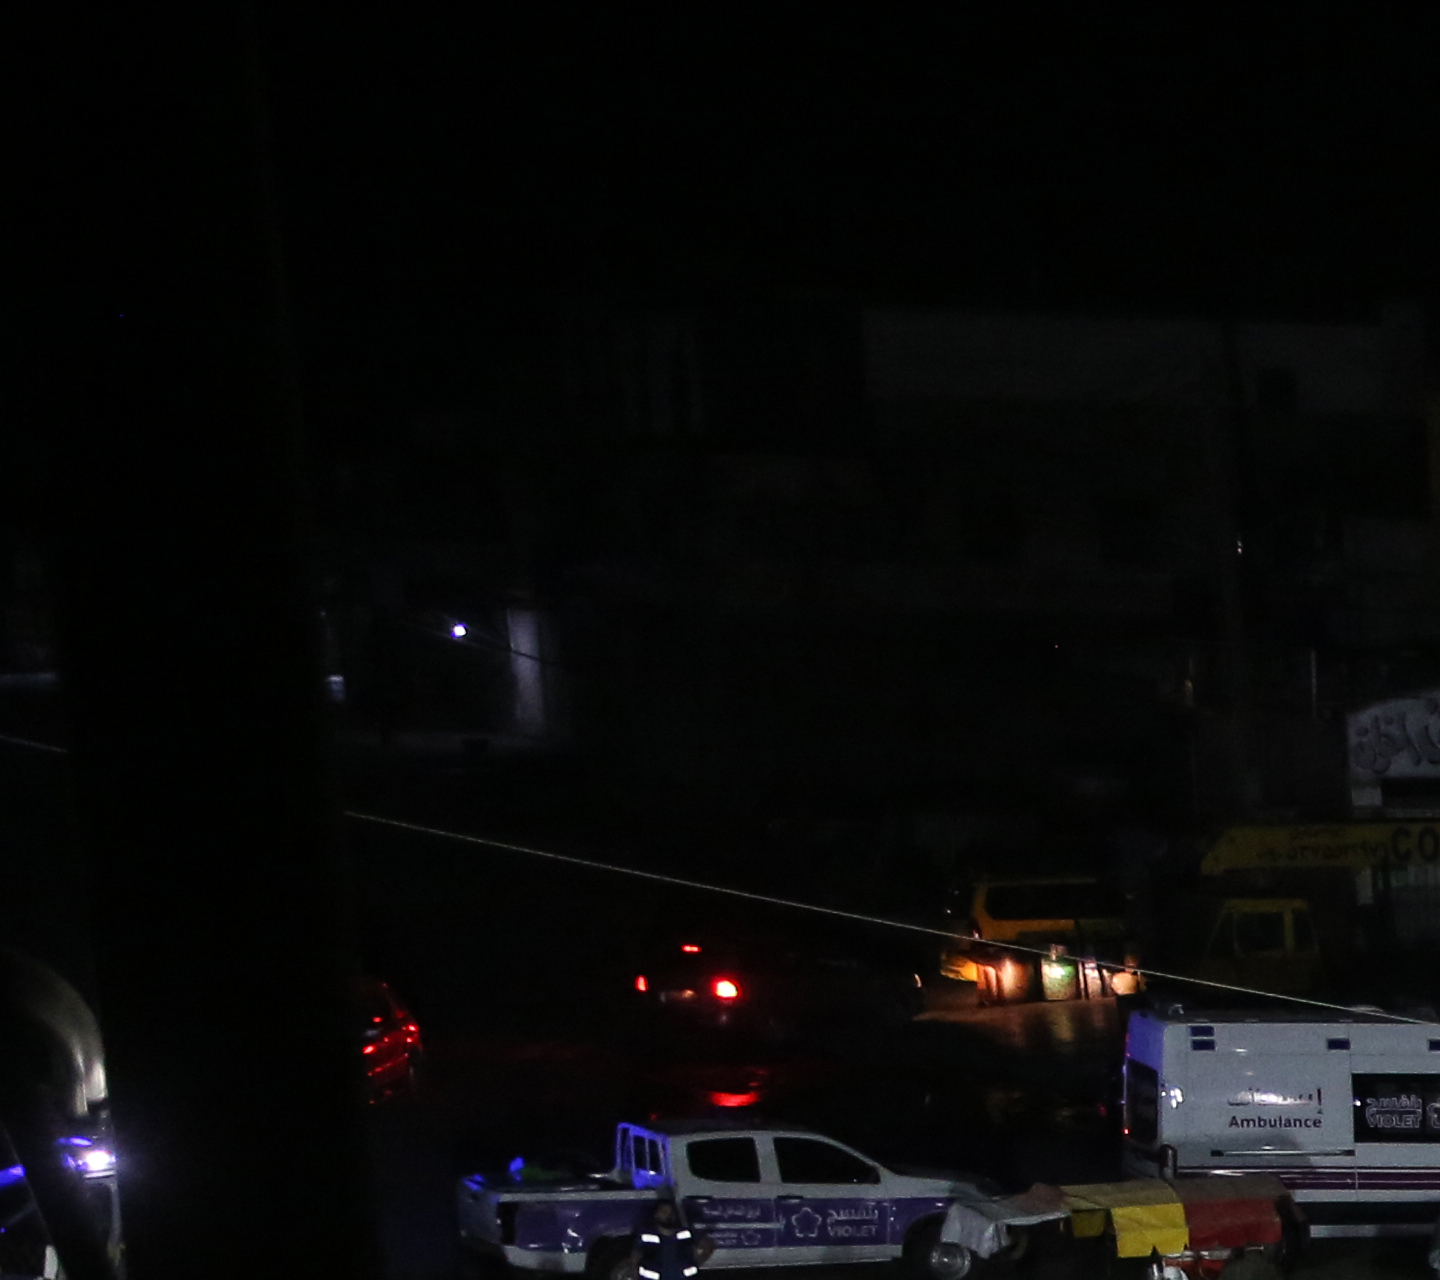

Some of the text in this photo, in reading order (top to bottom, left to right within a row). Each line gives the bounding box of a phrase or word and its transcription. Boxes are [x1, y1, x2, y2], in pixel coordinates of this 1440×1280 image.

[1228, 1114, 1323, 1129] Ambulance
[1366, 1113, 1423, 1129] VIOLET
[828, 1224, 880, 1238] VIOLET
